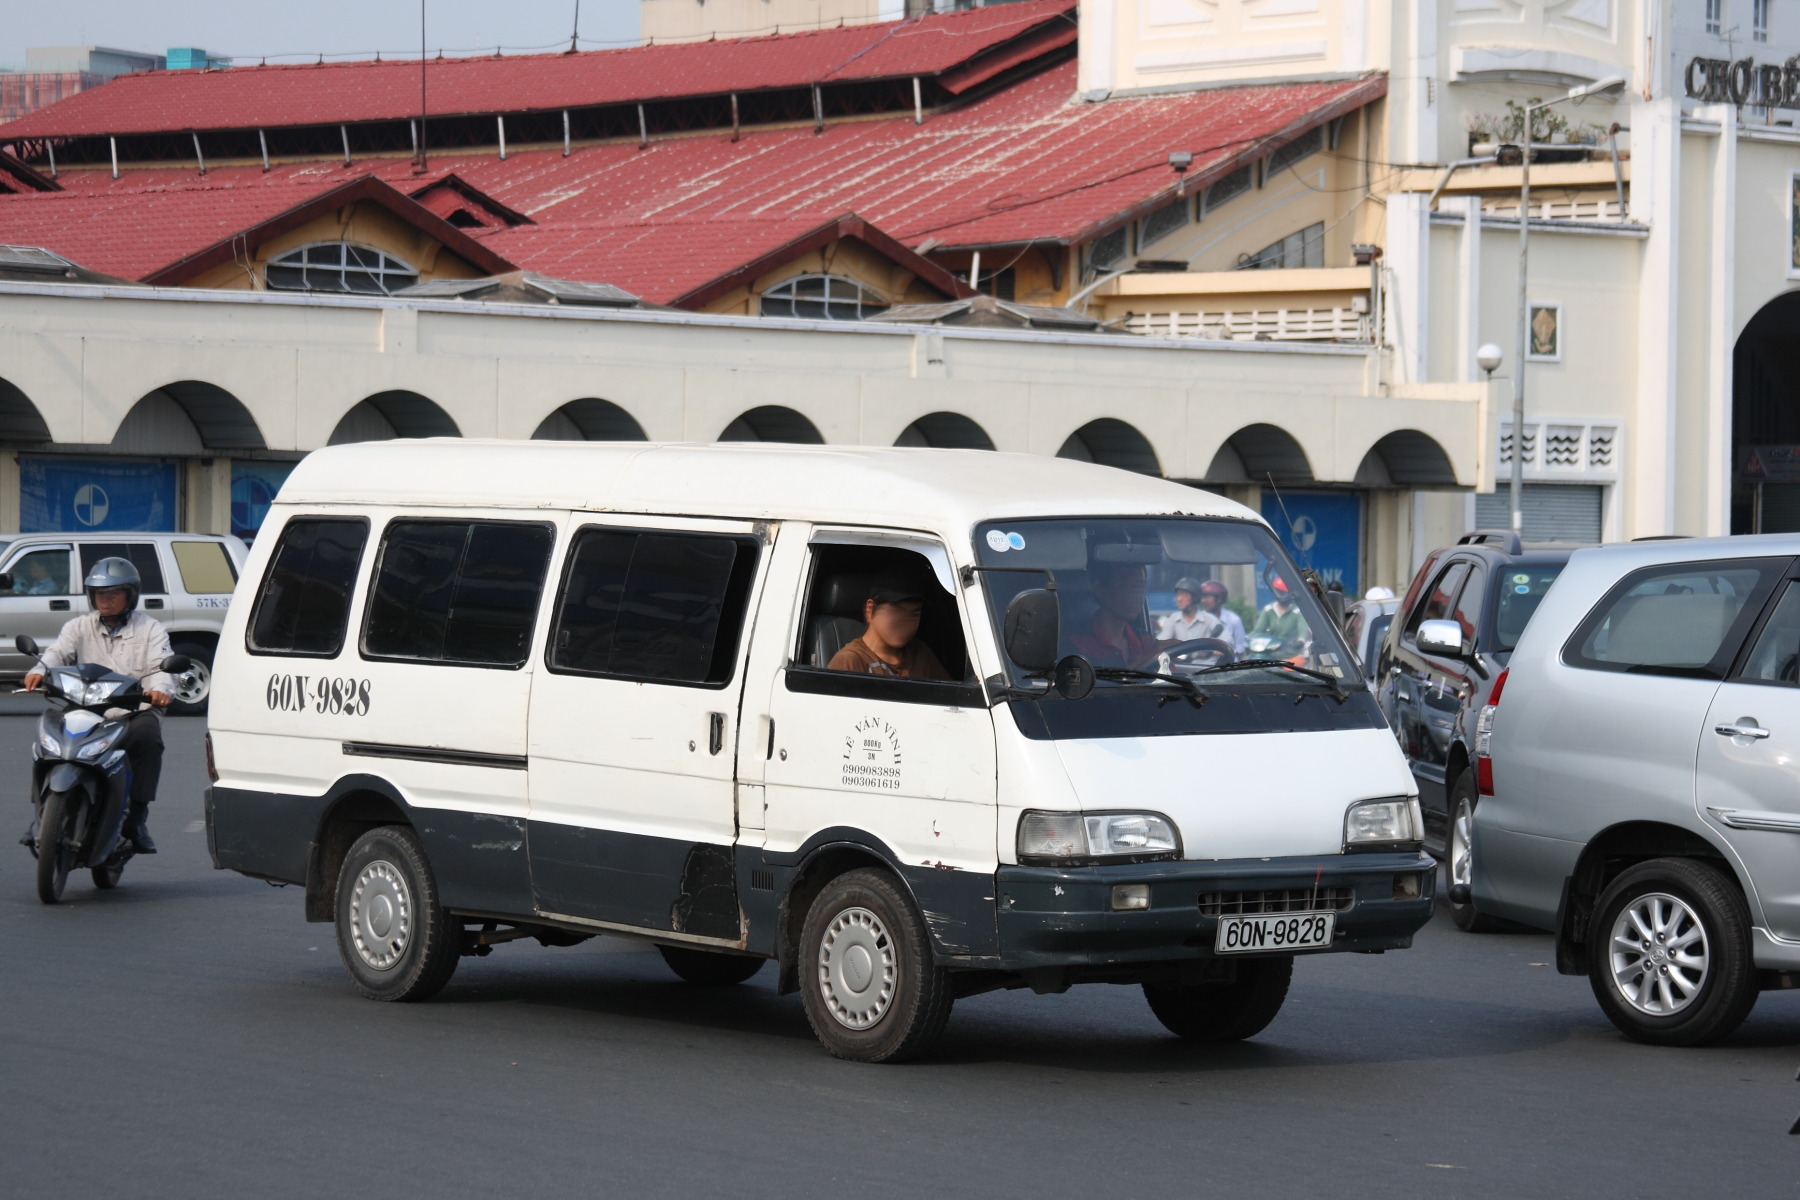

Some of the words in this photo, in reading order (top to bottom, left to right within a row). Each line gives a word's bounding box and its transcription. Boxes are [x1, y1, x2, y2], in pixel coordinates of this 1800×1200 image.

[197, 598, 233, 608] 57K-3
[266, 673, 371, 717] 60N-9828
[842, 775, 900, 789] 0903061619
[1226, 917, 1326, 948] 60N-9828
